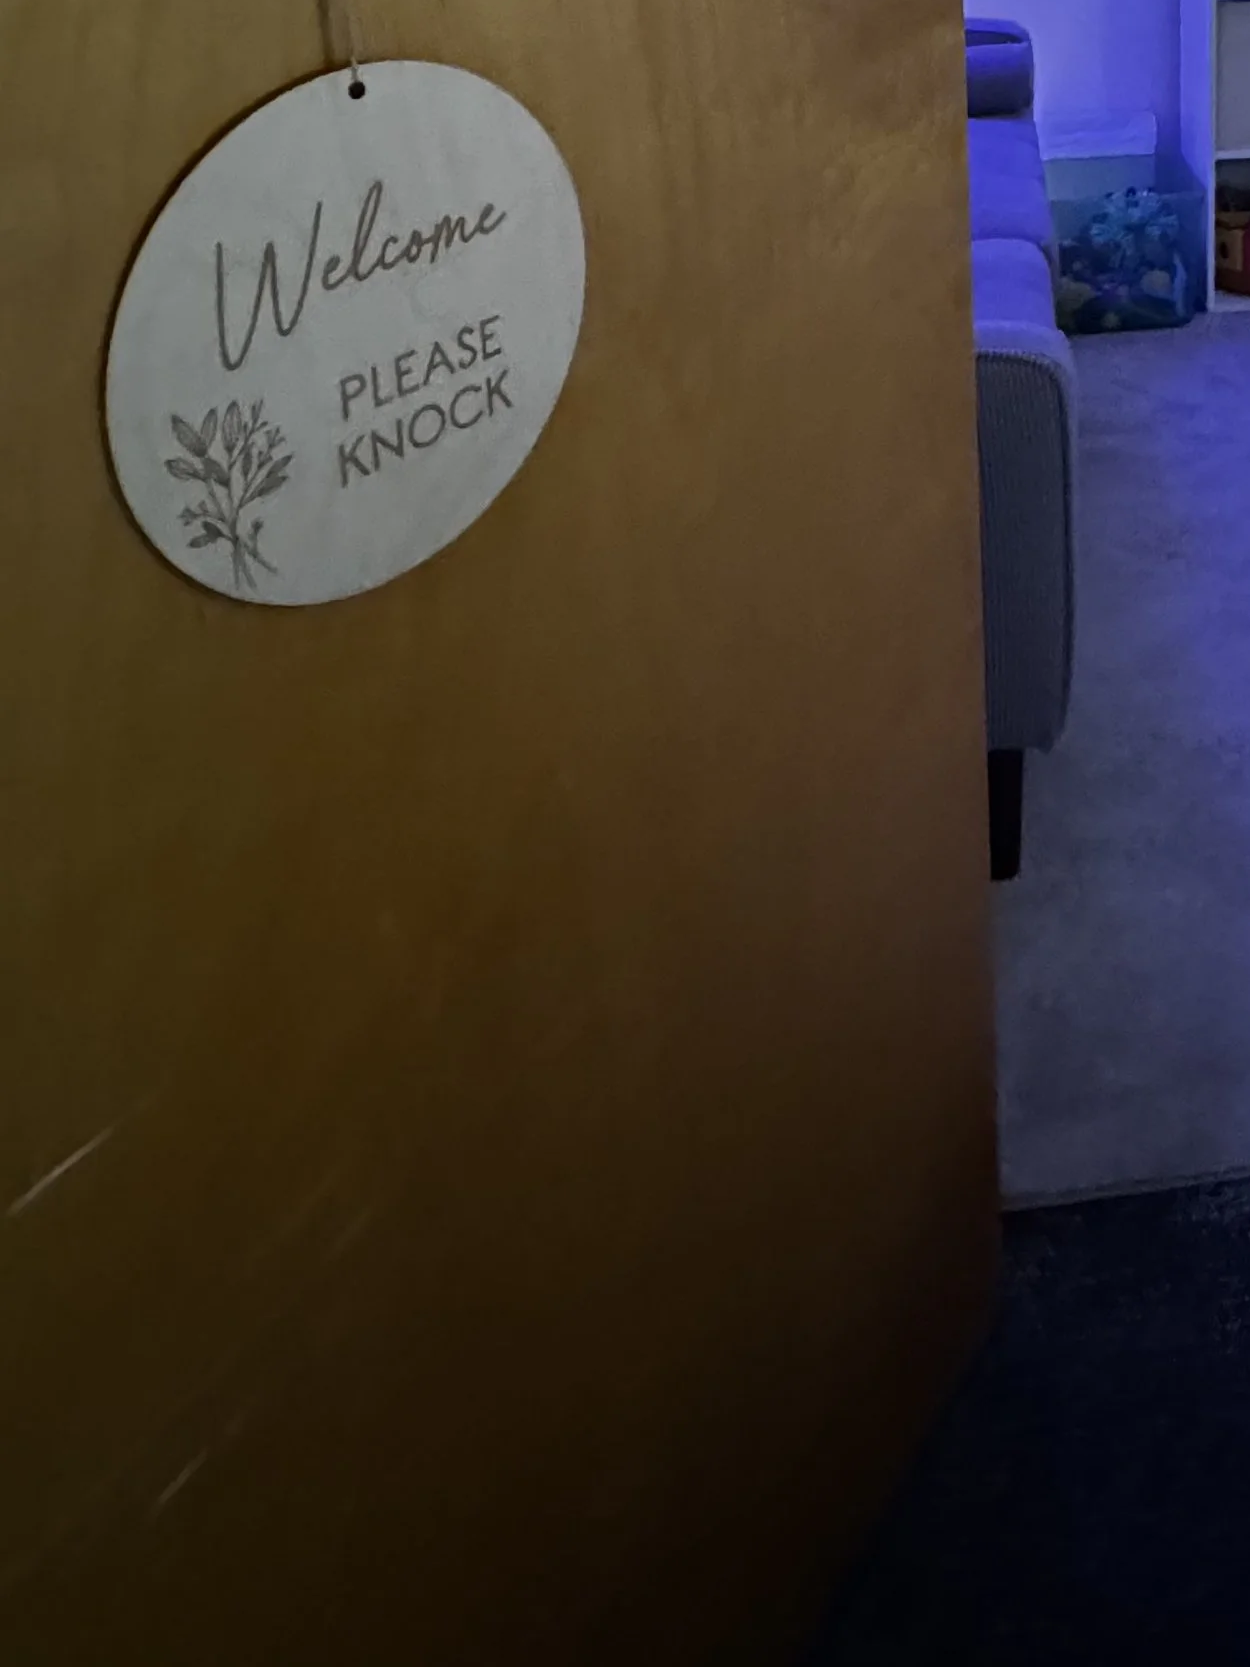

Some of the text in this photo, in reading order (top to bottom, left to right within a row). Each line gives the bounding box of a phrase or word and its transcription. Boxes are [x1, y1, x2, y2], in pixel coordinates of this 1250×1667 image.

[214, 179, 508, 372] Welcome
[338, 314, 504, 421] PLEASE
[335, 370, 514, 489] KNOCK
